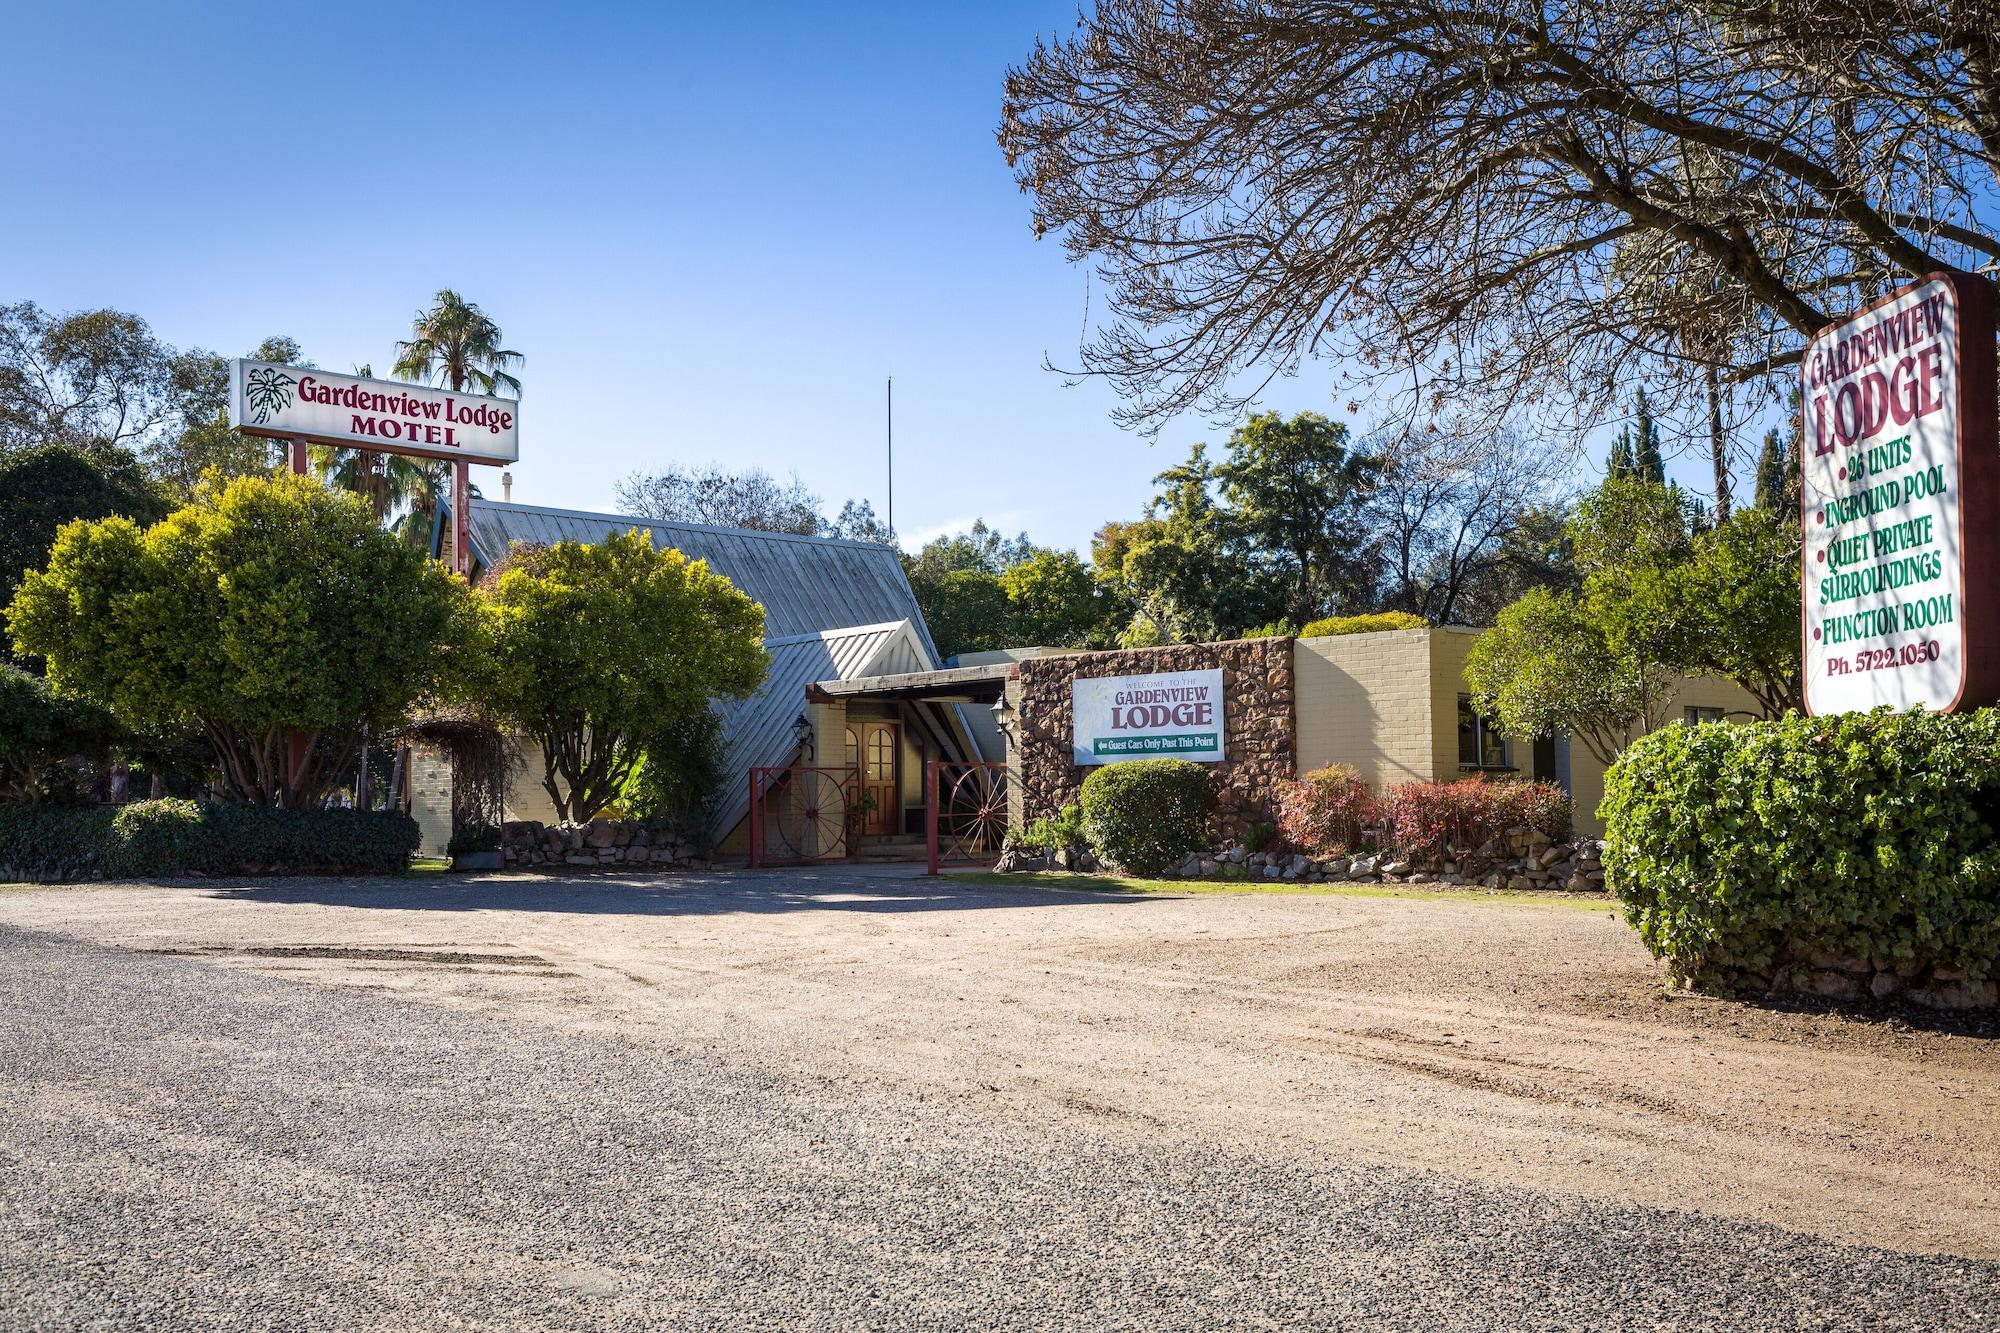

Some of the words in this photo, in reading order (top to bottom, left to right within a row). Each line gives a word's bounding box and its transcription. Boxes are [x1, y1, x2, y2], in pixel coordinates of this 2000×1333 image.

[1810, 293, 1946, 391] GARDENVIEW
[298, 376, 442, 420] Gardenview
[445, 397, 513, 434] Lodge
[1814, 342, 1944, 458] LODGE
[350, 414, 461, 448] MOTEL
[1847, 458, 1865, 482] 26
[1868, 435, 1912, 476] UNITS
[1824, 479, 1900, 529] INGROUND
[1903, 464, 1947, 505] POOL
[1826, 532, 1870, 573] QUIET
[1873, 514, 1933, 559] PRIVATE
[1820, 549, 1942, 605] SURROUNDINGS
[1822, 605, 1899, 646] FUNCTION
[1902, 593, 1953, 631] ROOM
[1826, 656, 1853, 677] Ph.
[1855, 639, 1940, 673] 5722.1050
[1115, 686, 1209, 706] GARDENVIEW
[1126, 680, 1164, 689] WELCOME
[1169, 679, 1180, 687] TO
[1182, 678, 1197, 686] THE
[1111, 702, 1213, 730] LODGE
[1108, 740, 1127, 750] Guest
[1127, 739, 1143, 749] Cars
[1144, 738, 1161, 751] Only
[1162, 738, 1177, 748] Past
[1178, 737, 1194, 747] This
[1194, 736, 1214, 747] Point
